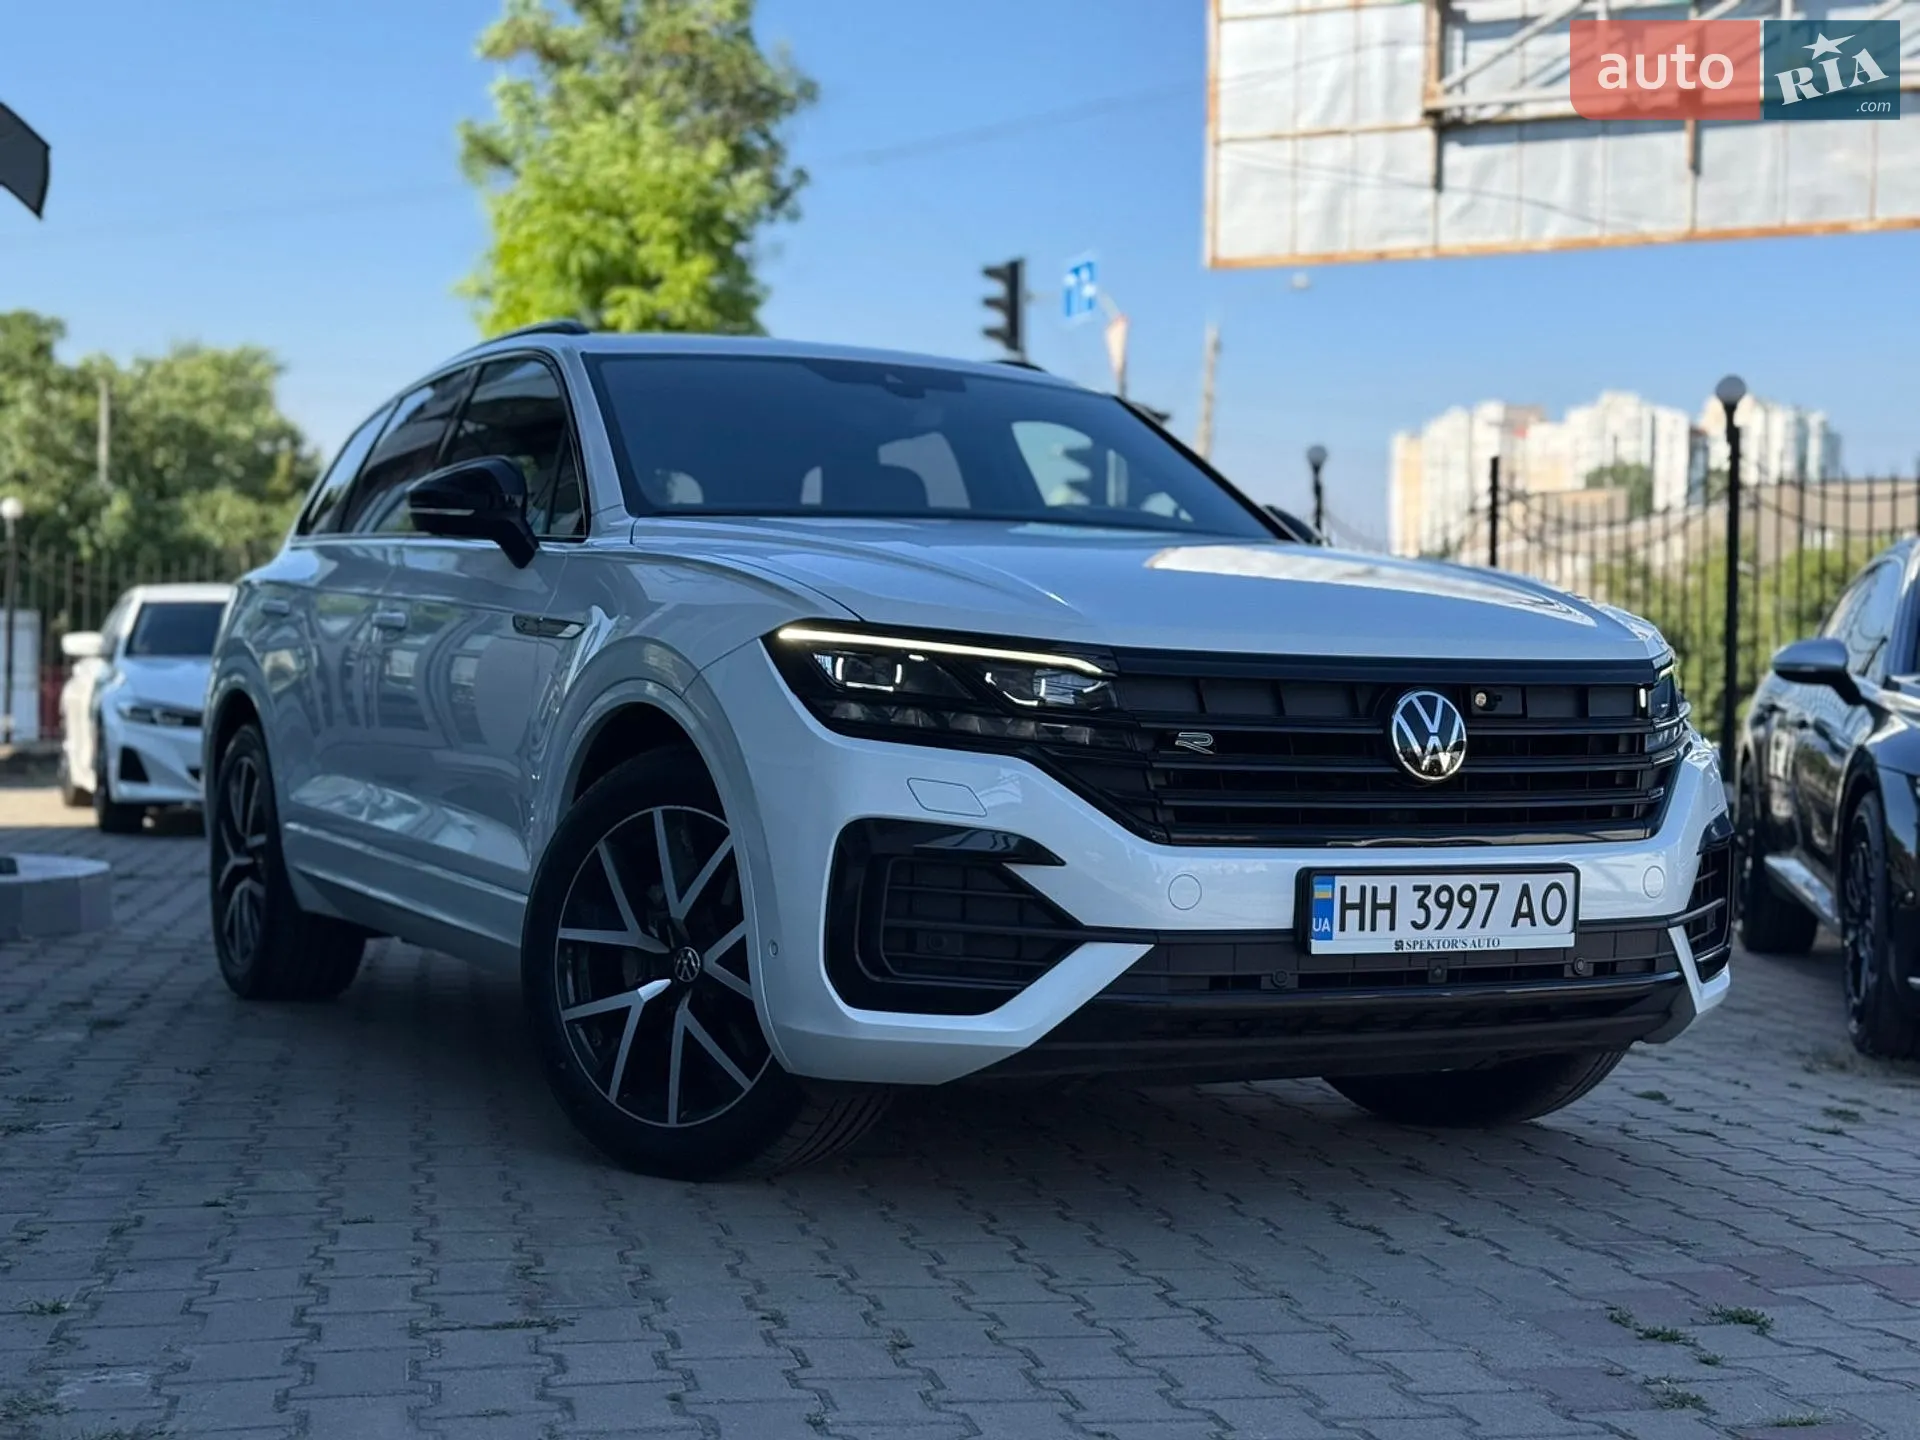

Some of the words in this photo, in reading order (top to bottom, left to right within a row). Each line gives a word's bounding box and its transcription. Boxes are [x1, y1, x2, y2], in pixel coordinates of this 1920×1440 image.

[1338, 884, 1398, 932] HH
[1410, 882, 1500, 931] 3997
[1510, 881, 1568, 928] AO
[1312, 920, 1331, 933] UA
[1405, 938, 1469, 951] SPEKTOR'S
[1469, 937, 1500, 949] AUTO
